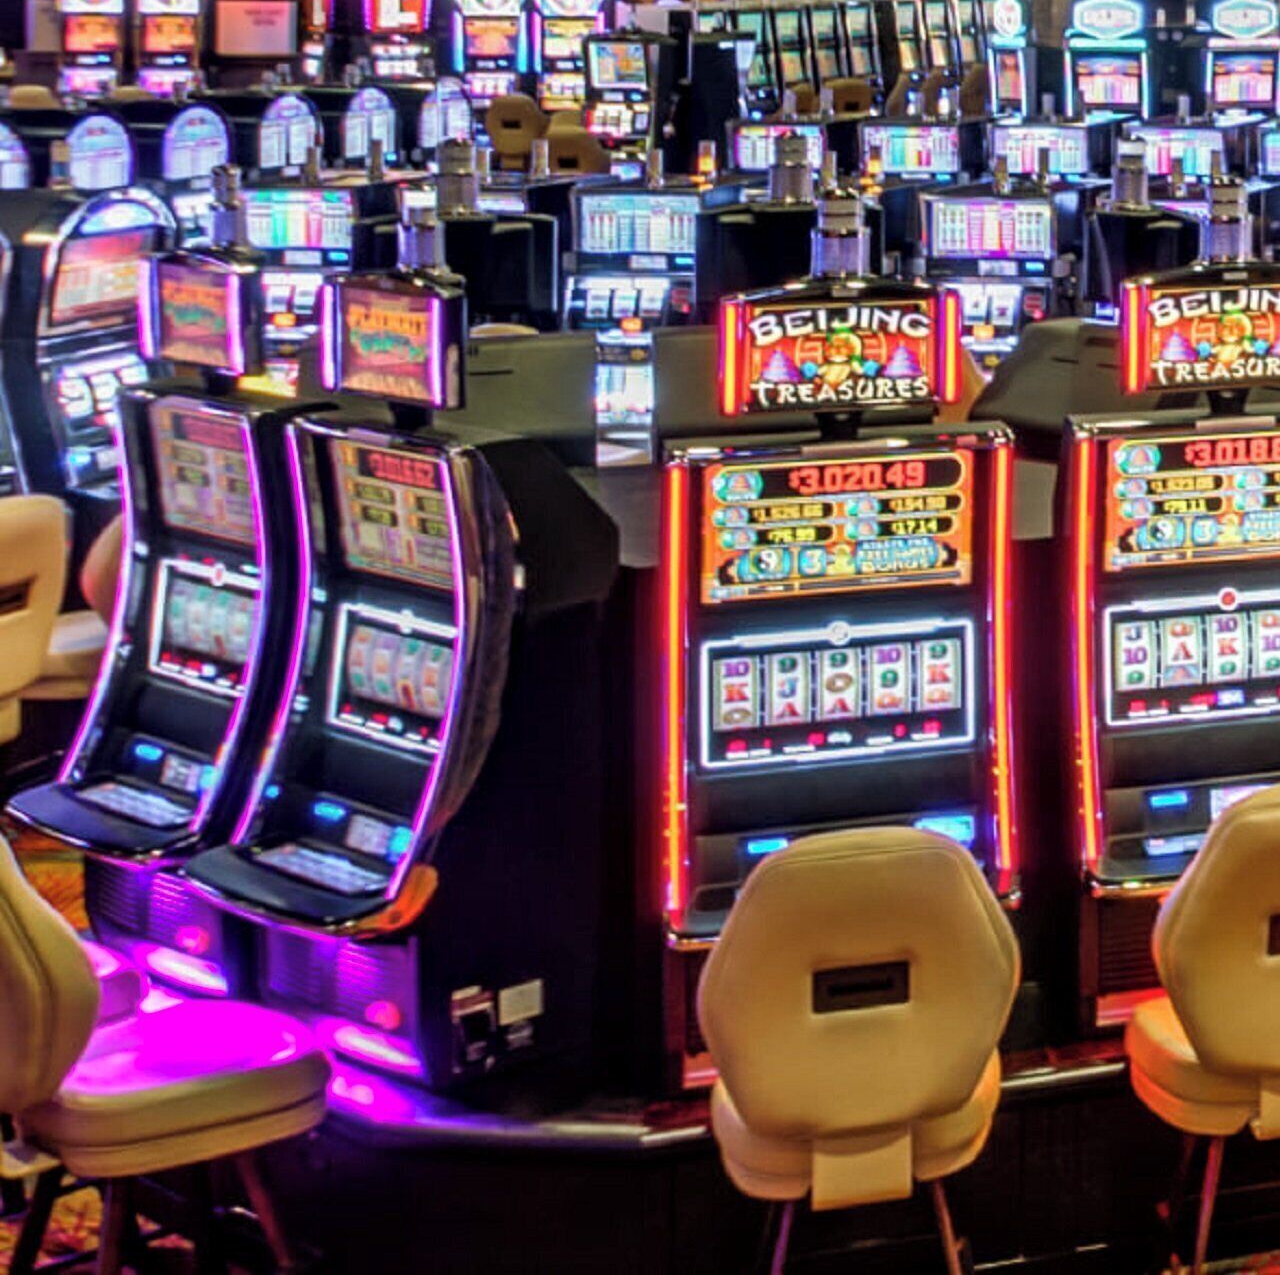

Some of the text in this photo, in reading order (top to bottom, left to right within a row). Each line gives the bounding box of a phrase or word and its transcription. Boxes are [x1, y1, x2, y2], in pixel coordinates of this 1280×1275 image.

[749, 307, 931, 346] BEIJING
[750, 376, 930, 408] TREASURES
[1214, 617, 1238, 633] 10
[724, 661, 750, 677] 10
[876, 646, 901, 664] 10
[1123, 648, 1148, 665] 10
[1172, 642, 1194, 661] A
[1218, 637, 1239, 656] K
[724, 683, 749, 703] K
[927, 663, 950, 684] K
